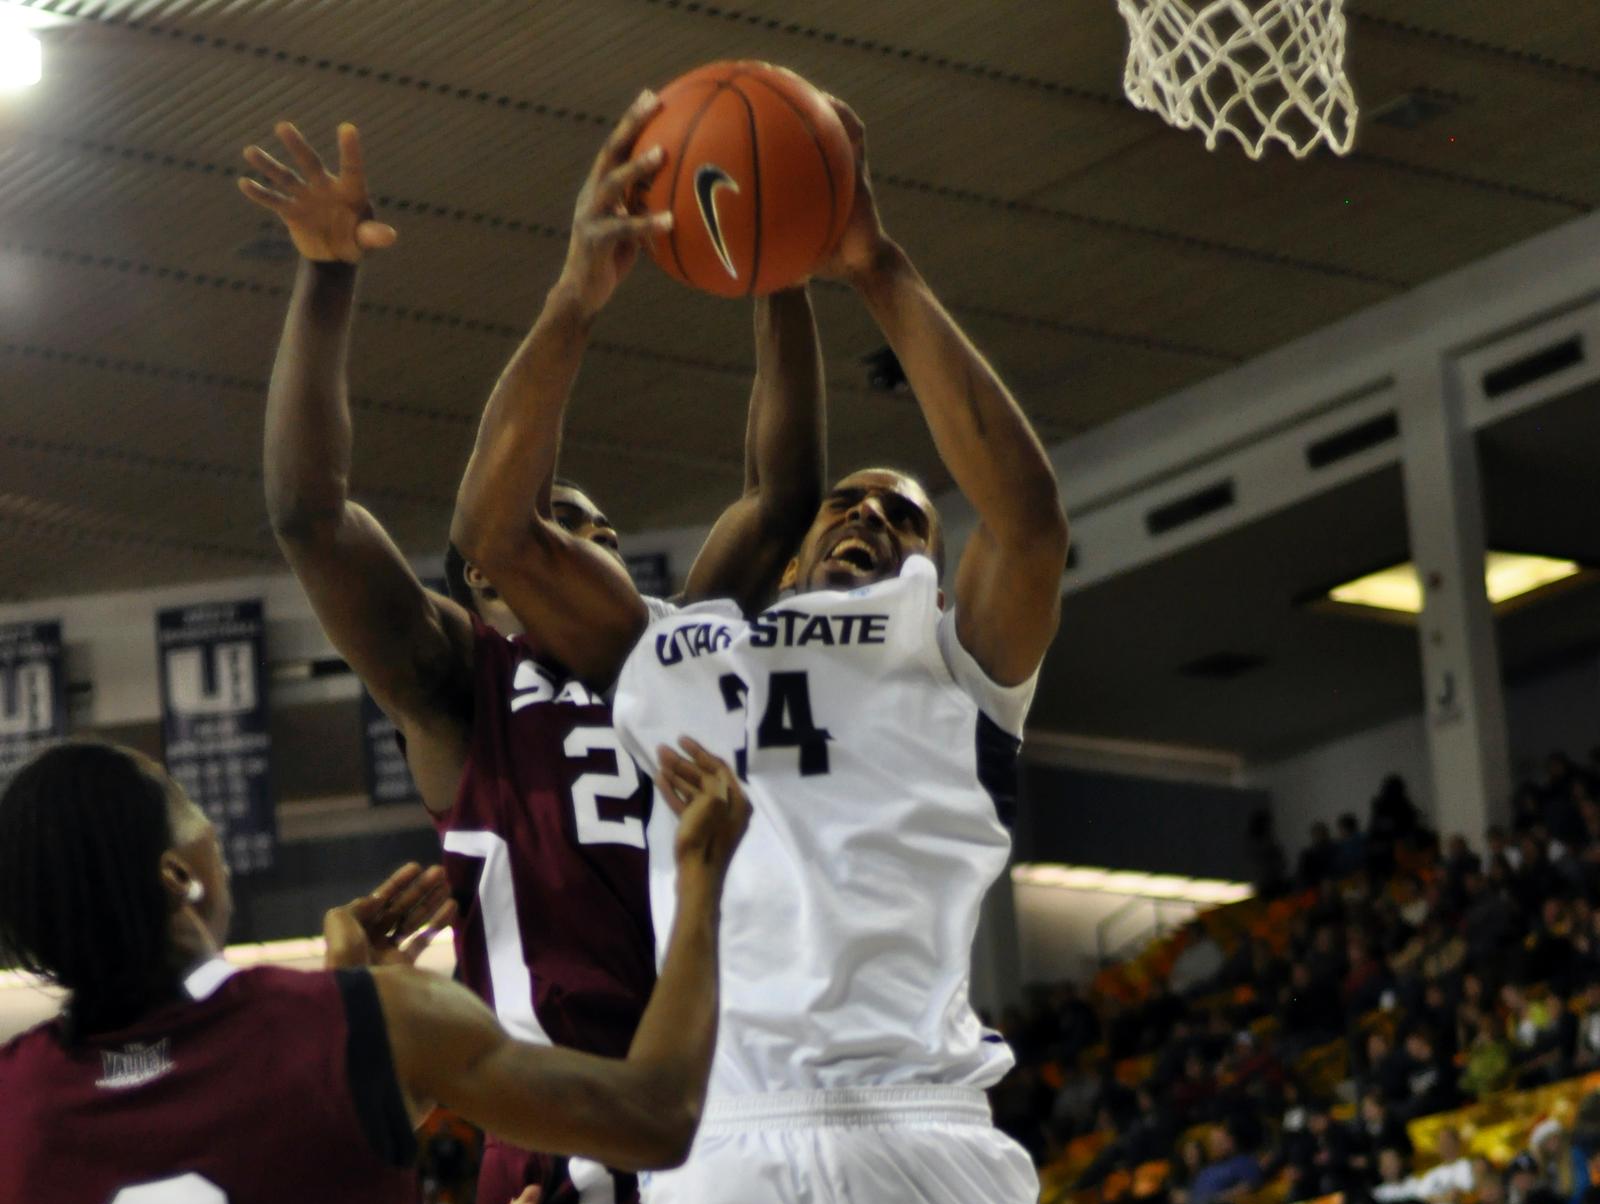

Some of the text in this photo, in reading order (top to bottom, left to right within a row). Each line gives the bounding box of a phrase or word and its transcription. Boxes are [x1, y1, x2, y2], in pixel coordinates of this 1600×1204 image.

[751, 610, 889, 647] STATE
[511, 659, 606, 713] SA
[563, 727, 647, 850] 2
